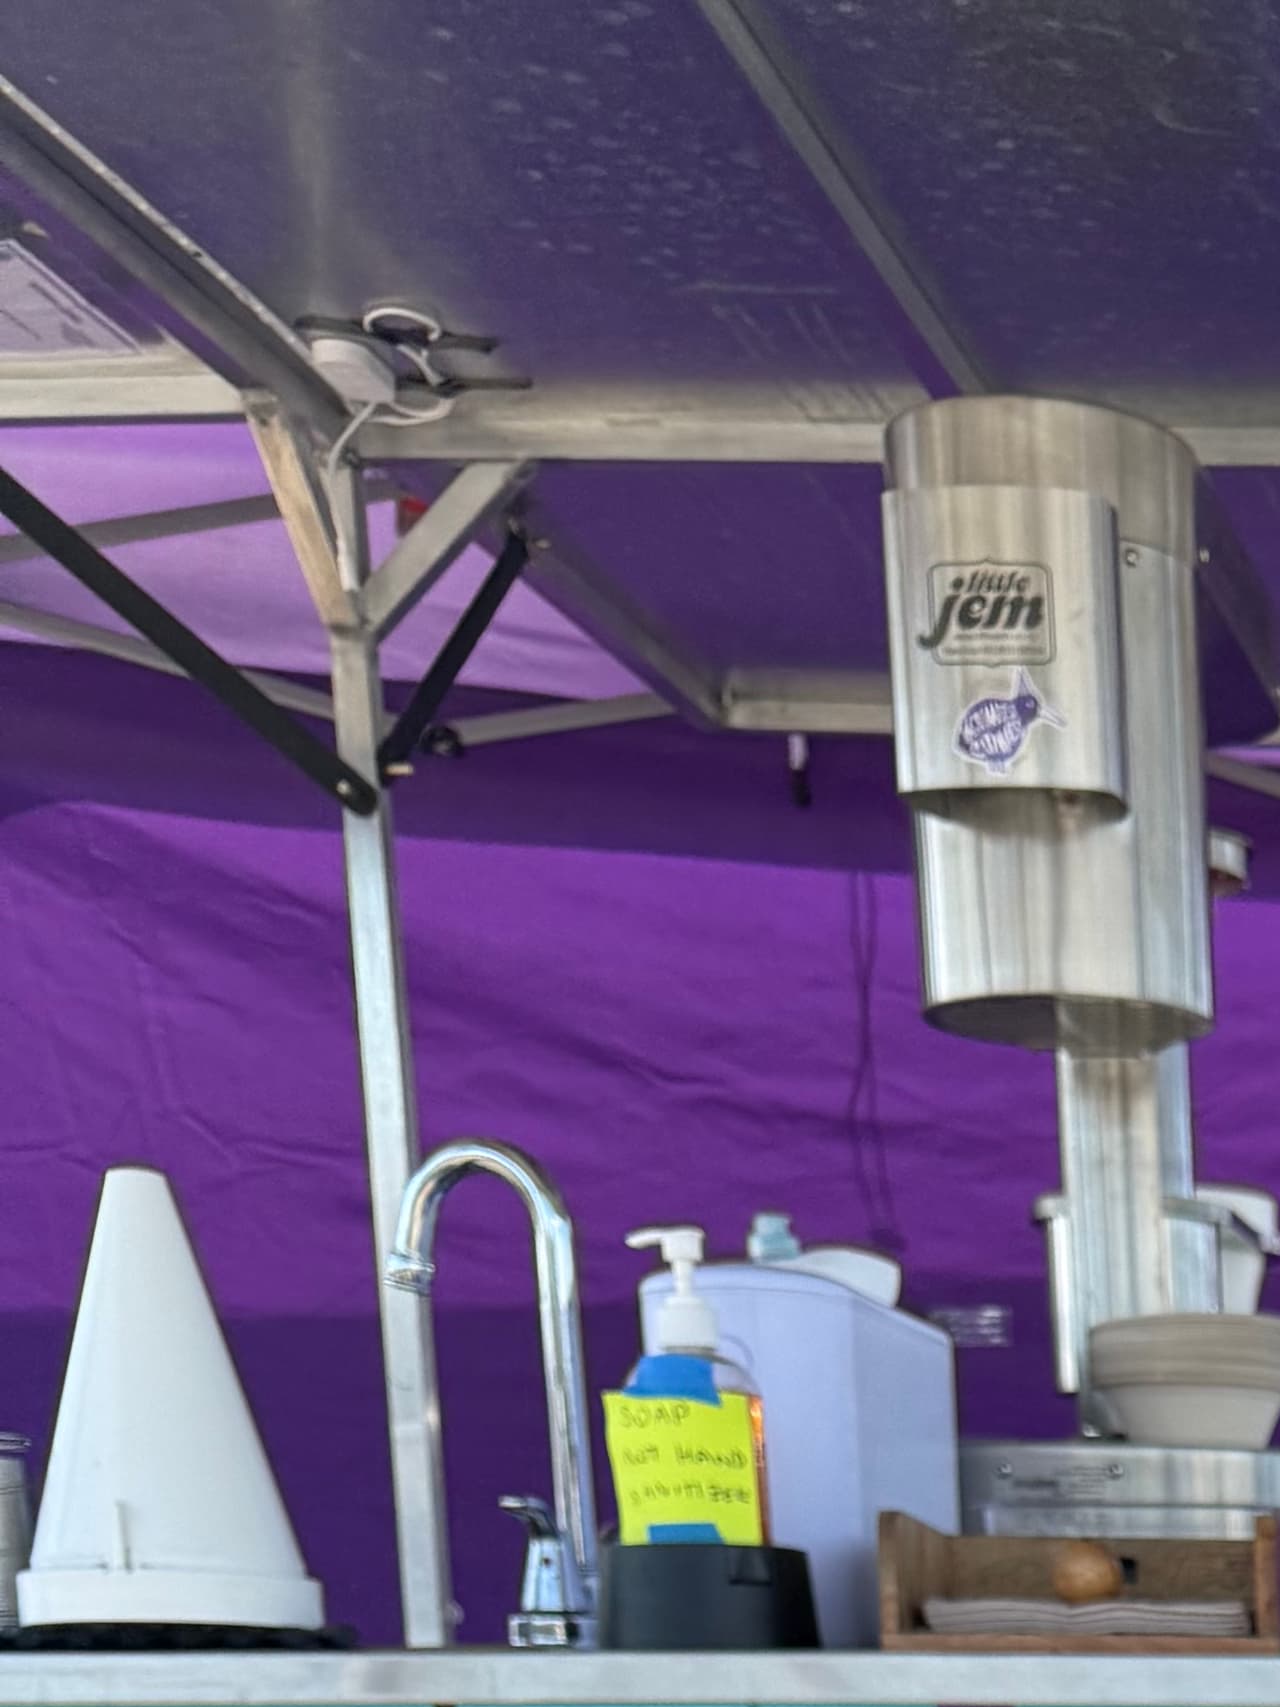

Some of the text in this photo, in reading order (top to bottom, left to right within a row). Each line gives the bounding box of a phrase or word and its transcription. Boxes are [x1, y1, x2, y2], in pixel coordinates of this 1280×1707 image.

[965, 569, 1031, 594] little
[917, 577, 1046, 648] jem
[620, 1401, 690, 1428] SOAP
[623, 1443, 747, 1469] NOT HAND
